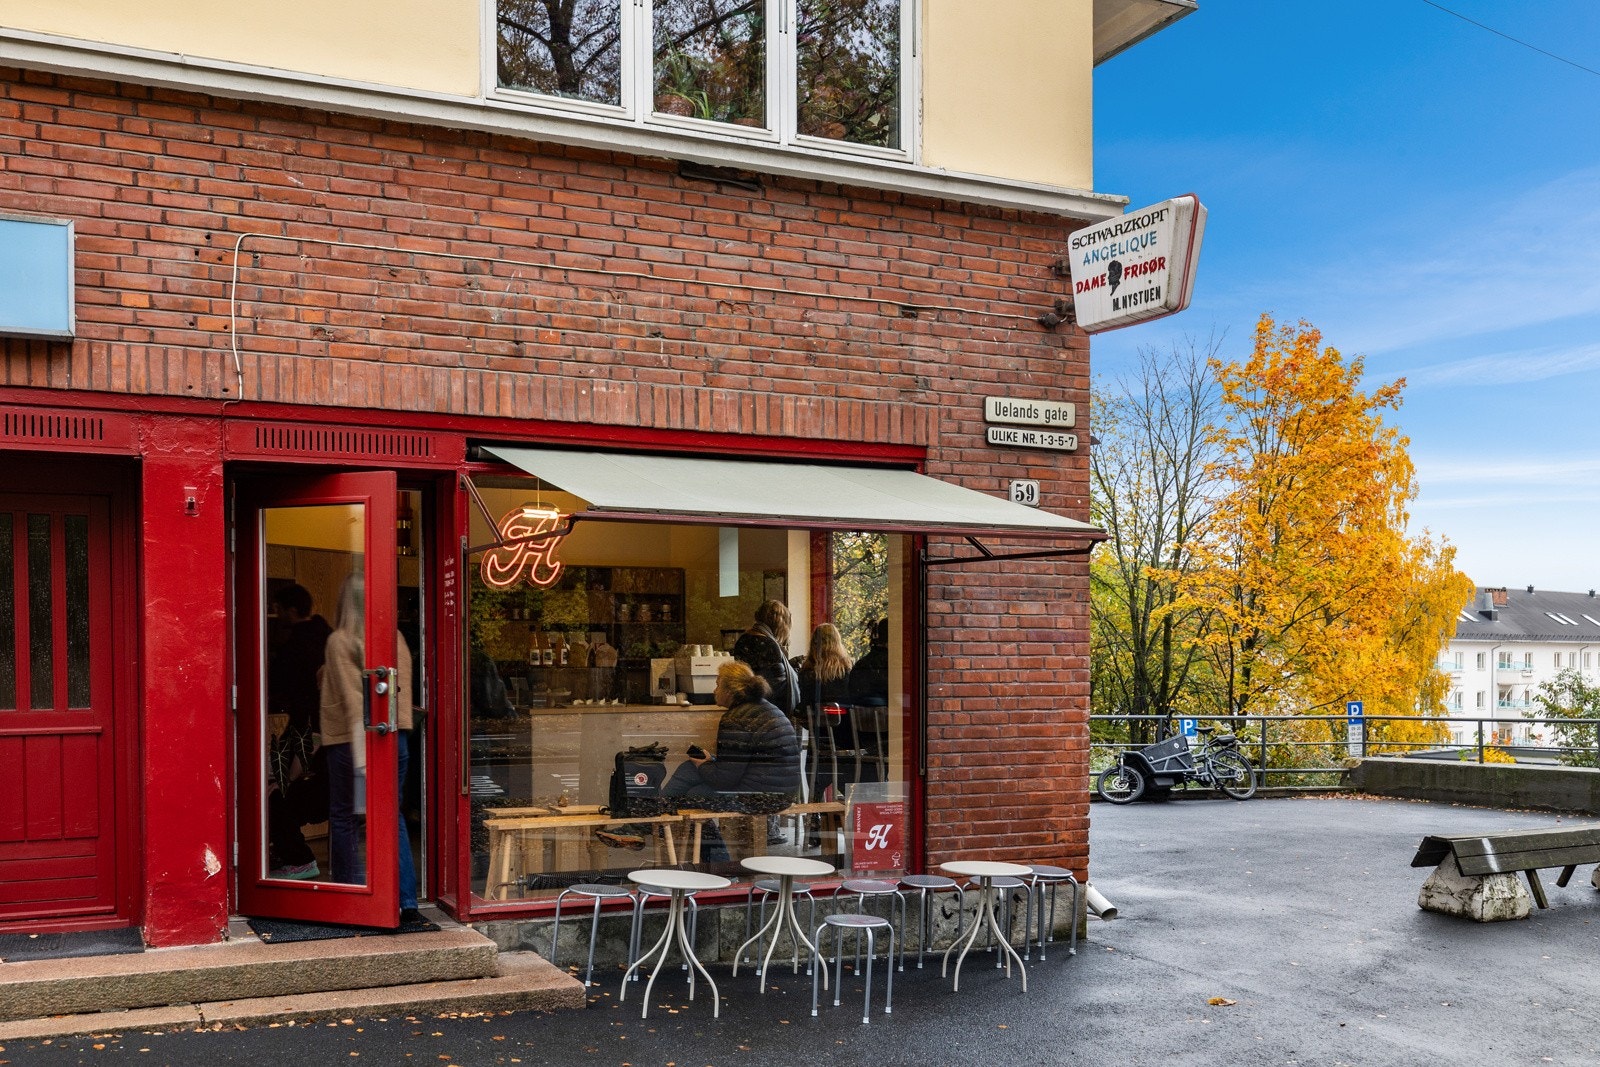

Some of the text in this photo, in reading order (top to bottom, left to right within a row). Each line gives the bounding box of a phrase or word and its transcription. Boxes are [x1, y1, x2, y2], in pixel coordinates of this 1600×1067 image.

[1083, 231, 1158, 266] ANGELIQUE
[1076, 257, 1166, 294] DAME FRISØR
[994, 401, 1068, 423] Uelands gate
[991, 430, 1075, 447] ULIKE NR. 1-3-5-7
[1015, 483, 1035, 502] 59
